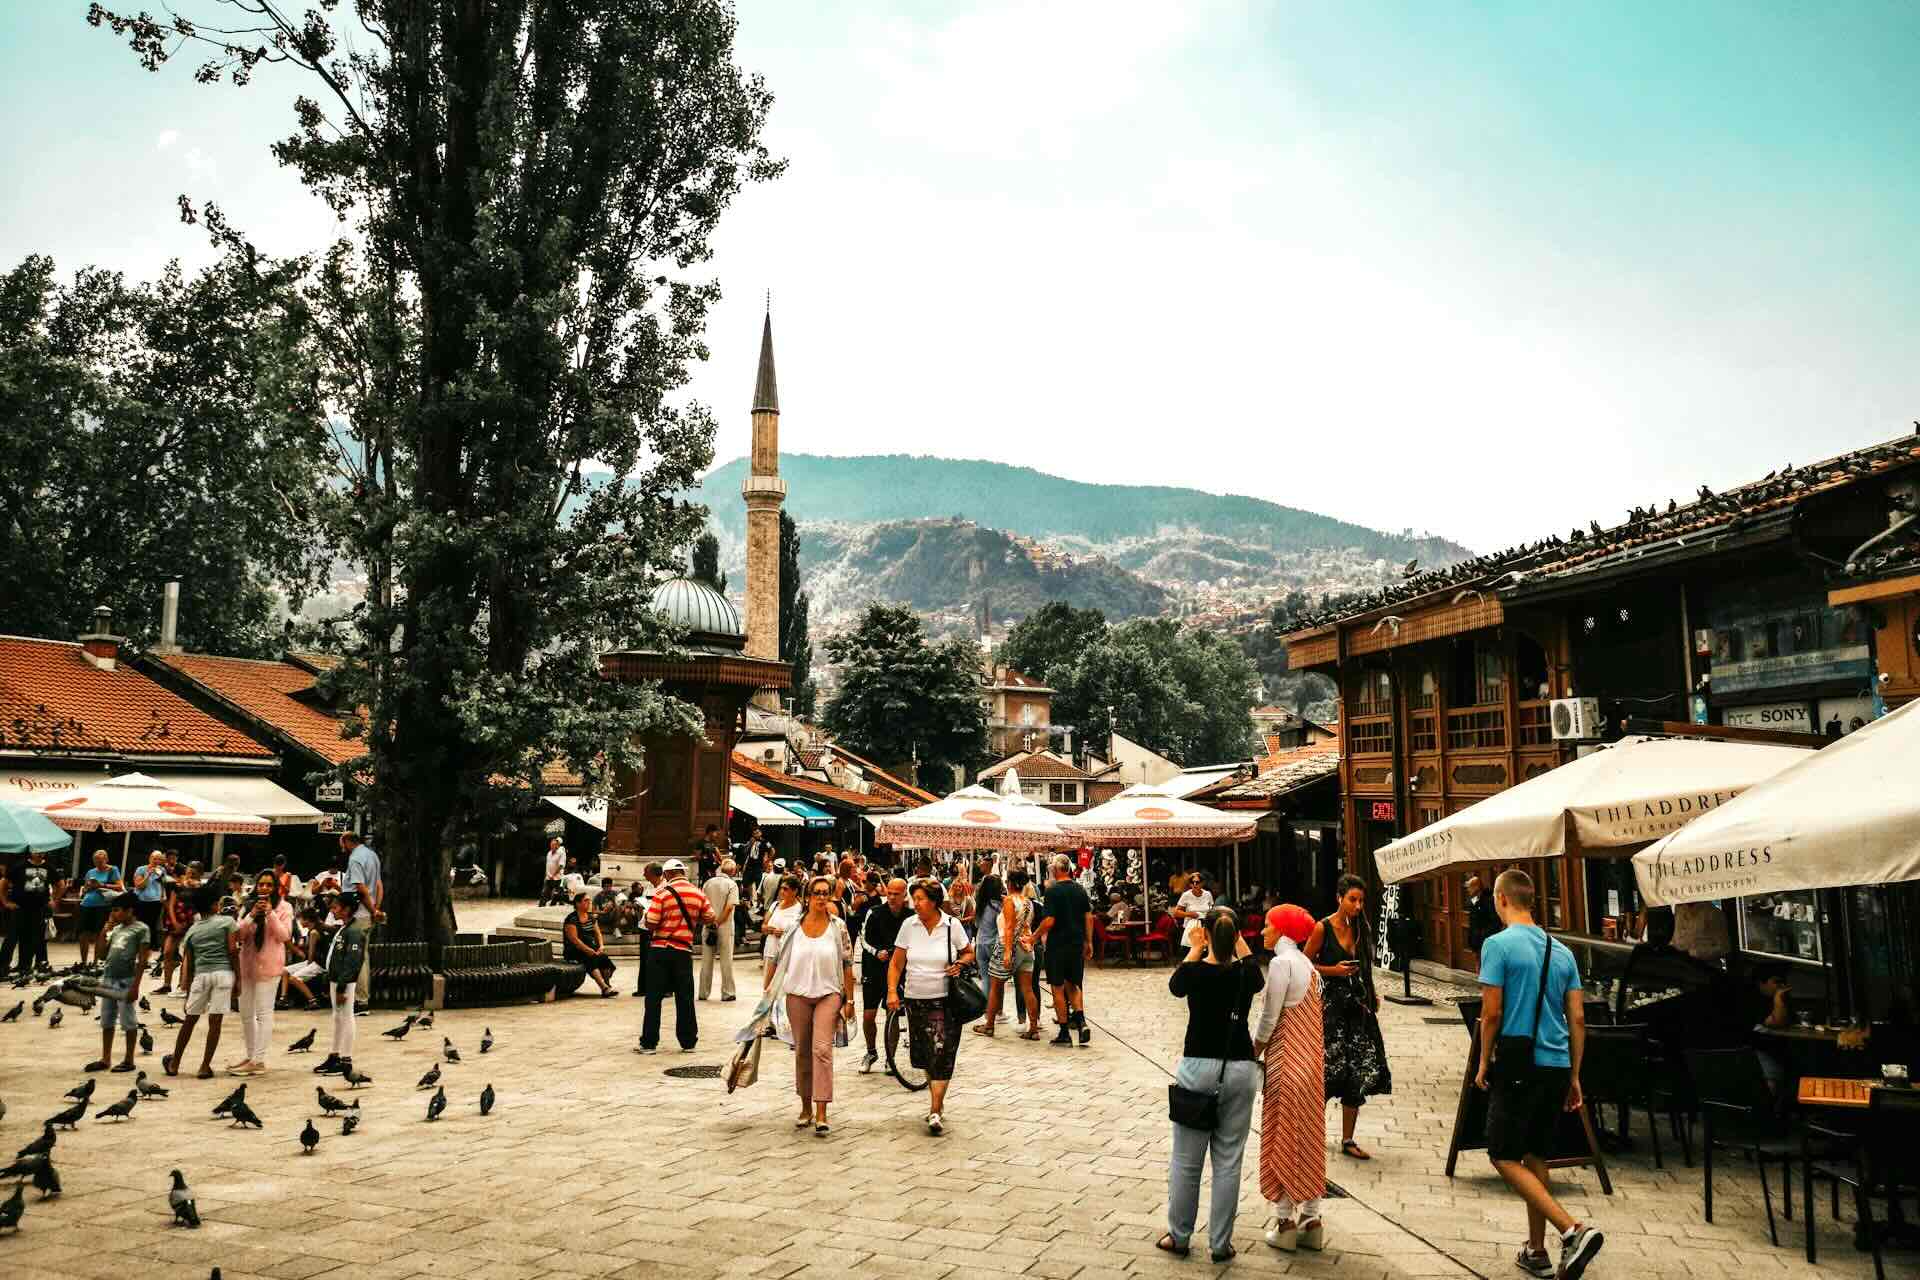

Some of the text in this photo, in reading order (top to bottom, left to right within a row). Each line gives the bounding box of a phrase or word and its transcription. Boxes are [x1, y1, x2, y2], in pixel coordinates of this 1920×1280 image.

[1760, 708, 1809, 723] SONY
[1402, 829, 1454, 857] ADDRESS
[1683, 845, 1772, 875] ADDRESS
